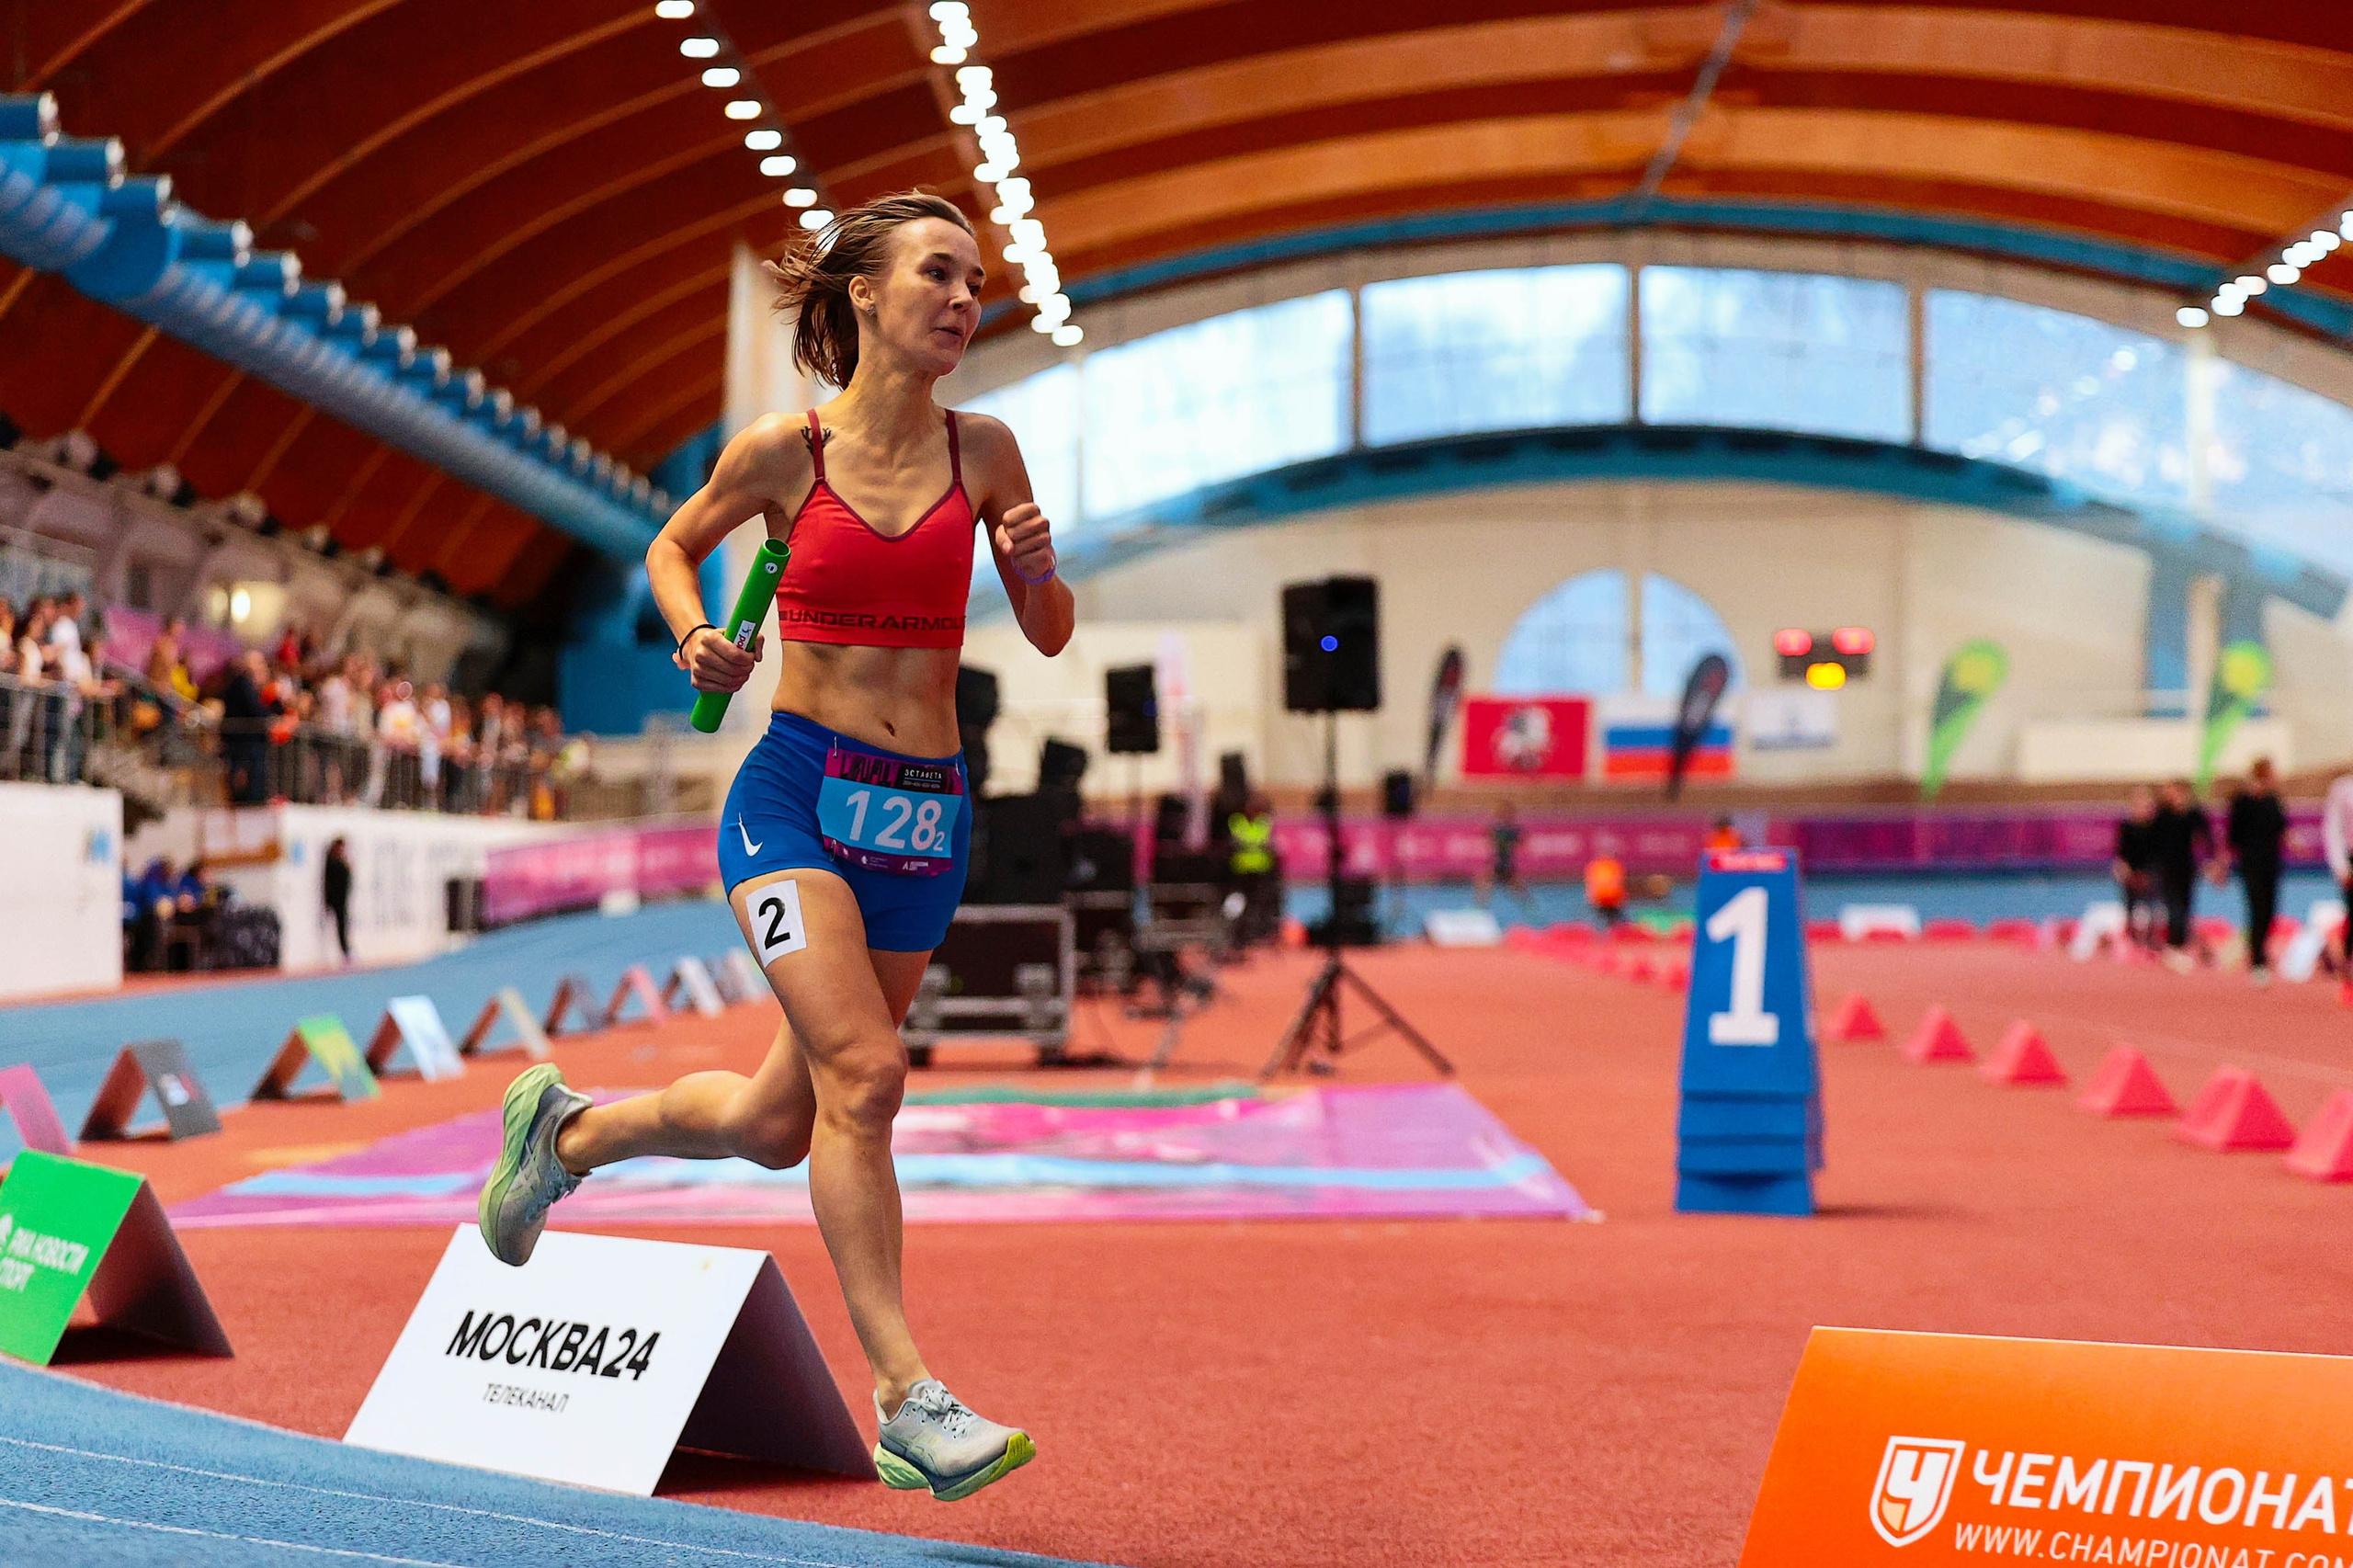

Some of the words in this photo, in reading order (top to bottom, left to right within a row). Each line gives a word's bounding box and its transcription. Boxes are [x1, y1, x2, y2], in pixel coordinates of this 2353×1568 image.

[846, 790, 942, 851] 128
[758, 897, 791, 950] 2
[1706, 886, 1779, 1046] 1
[445, 1310, 661, 1381] МОСКВА24
[483, 1382, 570, 1413] ТЕЛЕКАНАЛ
[1972, 1449, 2353, 1537] ЧЕМПИОНА
[1955, 1522, 2353, 1568] WWW.CHAMPIONATCO
